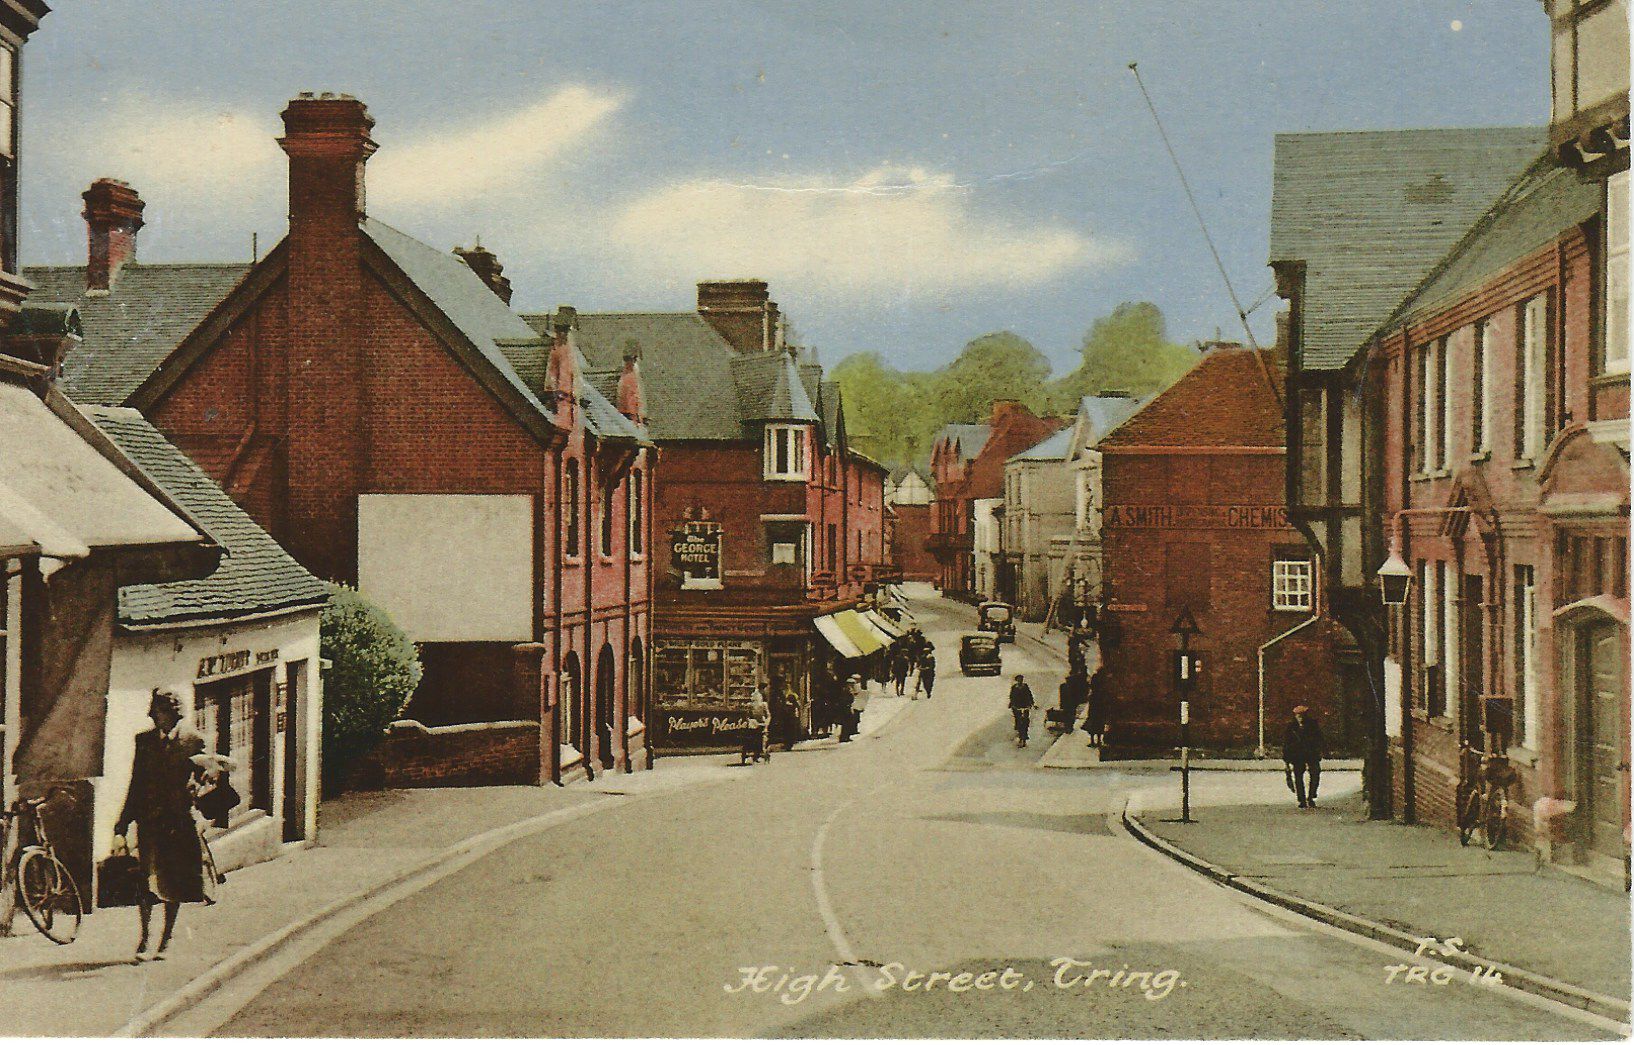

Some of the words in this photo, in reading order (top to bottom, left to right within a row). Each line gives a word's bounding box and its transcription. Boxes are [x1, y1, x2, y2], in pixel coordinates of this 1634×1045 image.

[1228, 507, 1289, 527] CHEMIS
[673, 543, 717, 553] GEORGE
[680, 554, 710, 563] HOTEL
